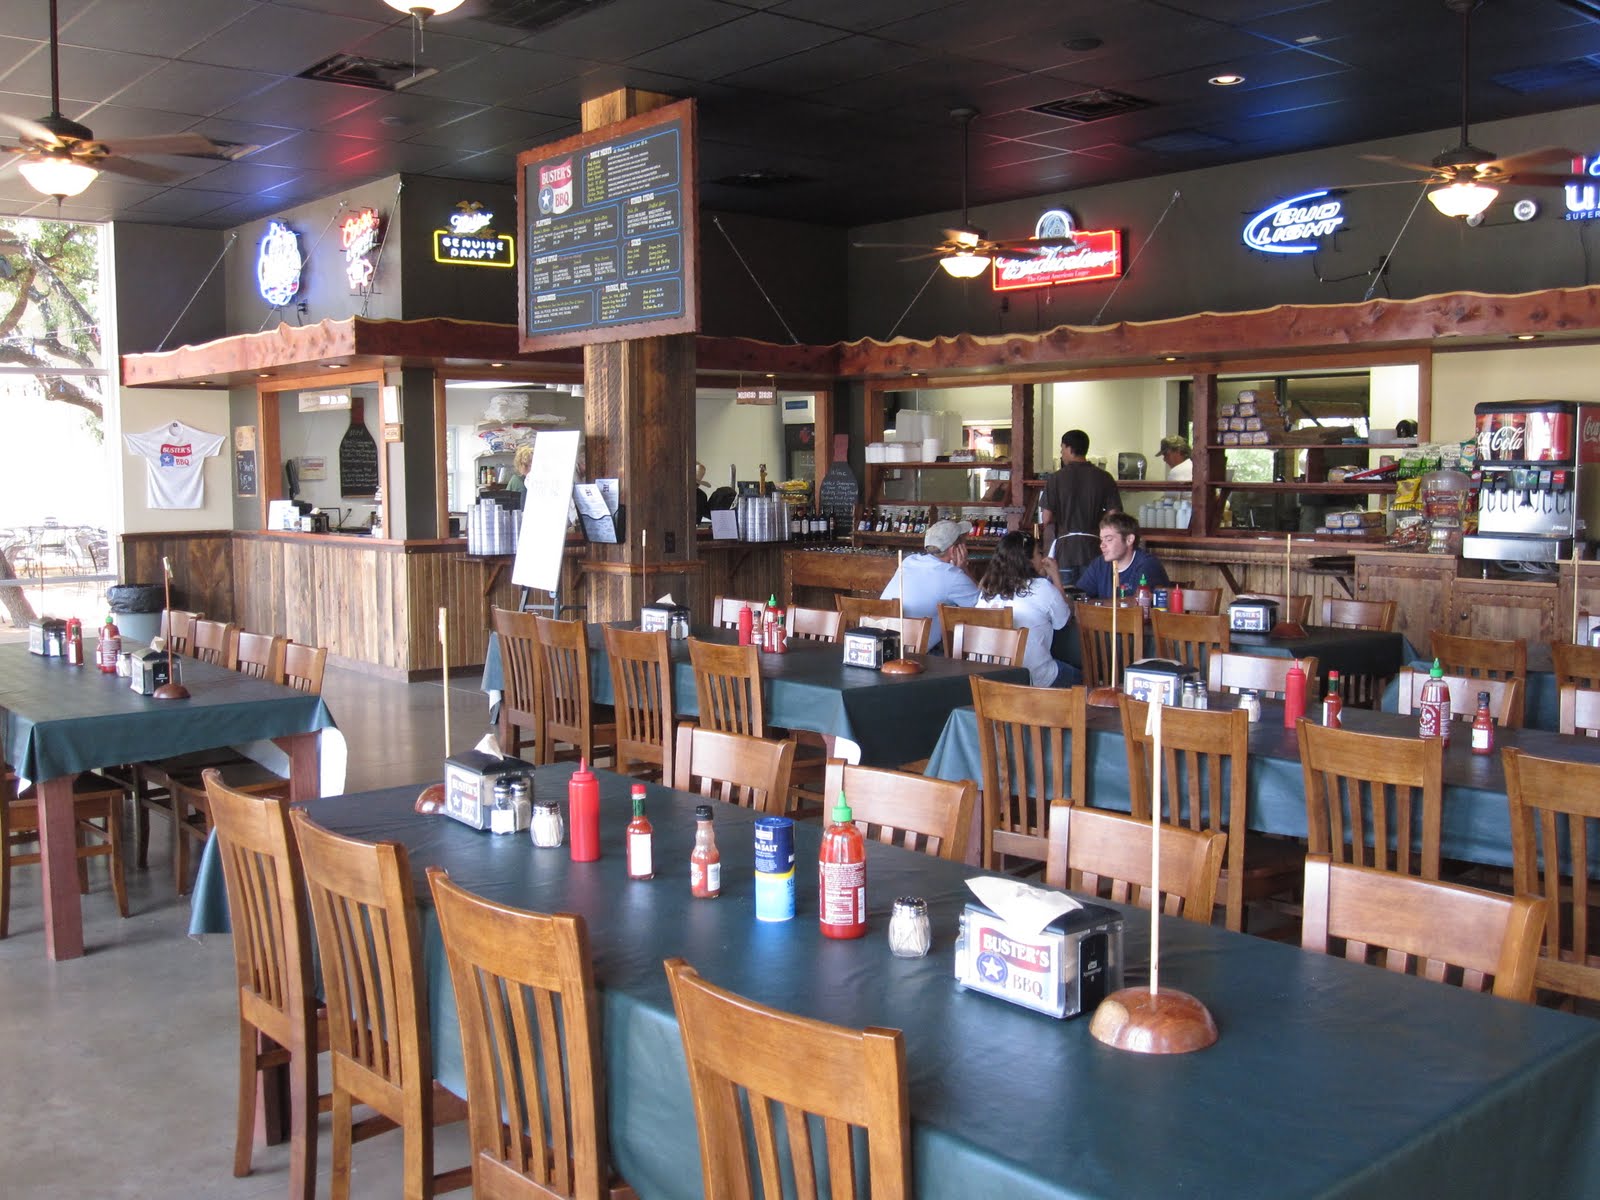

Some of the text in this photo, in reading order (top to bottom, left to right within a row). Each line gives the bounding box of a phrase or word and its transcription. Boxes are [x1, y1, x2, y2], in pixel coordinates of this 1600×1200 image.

[541, 165, 572, 185] BUSTER'S
[555, 192, 569, 207] BBQ
[1272, 202, 1341, 226] BUD
[1256, 217, 1343, 245] LIGHT
[442, 237, 504, 251] GENUINE
[450, 248, 495, 259] DRAFT
[1027, 275, 1036, 283] The
[1051, 271, 1074, 279] American
[1075, 270, 1089, 279] Lager
[1134, 680, 1170, 691] BUSTS
[983, 935, 1049, 967] BUSTER'S
[1013, 974, 1043, 1000] BBQ
